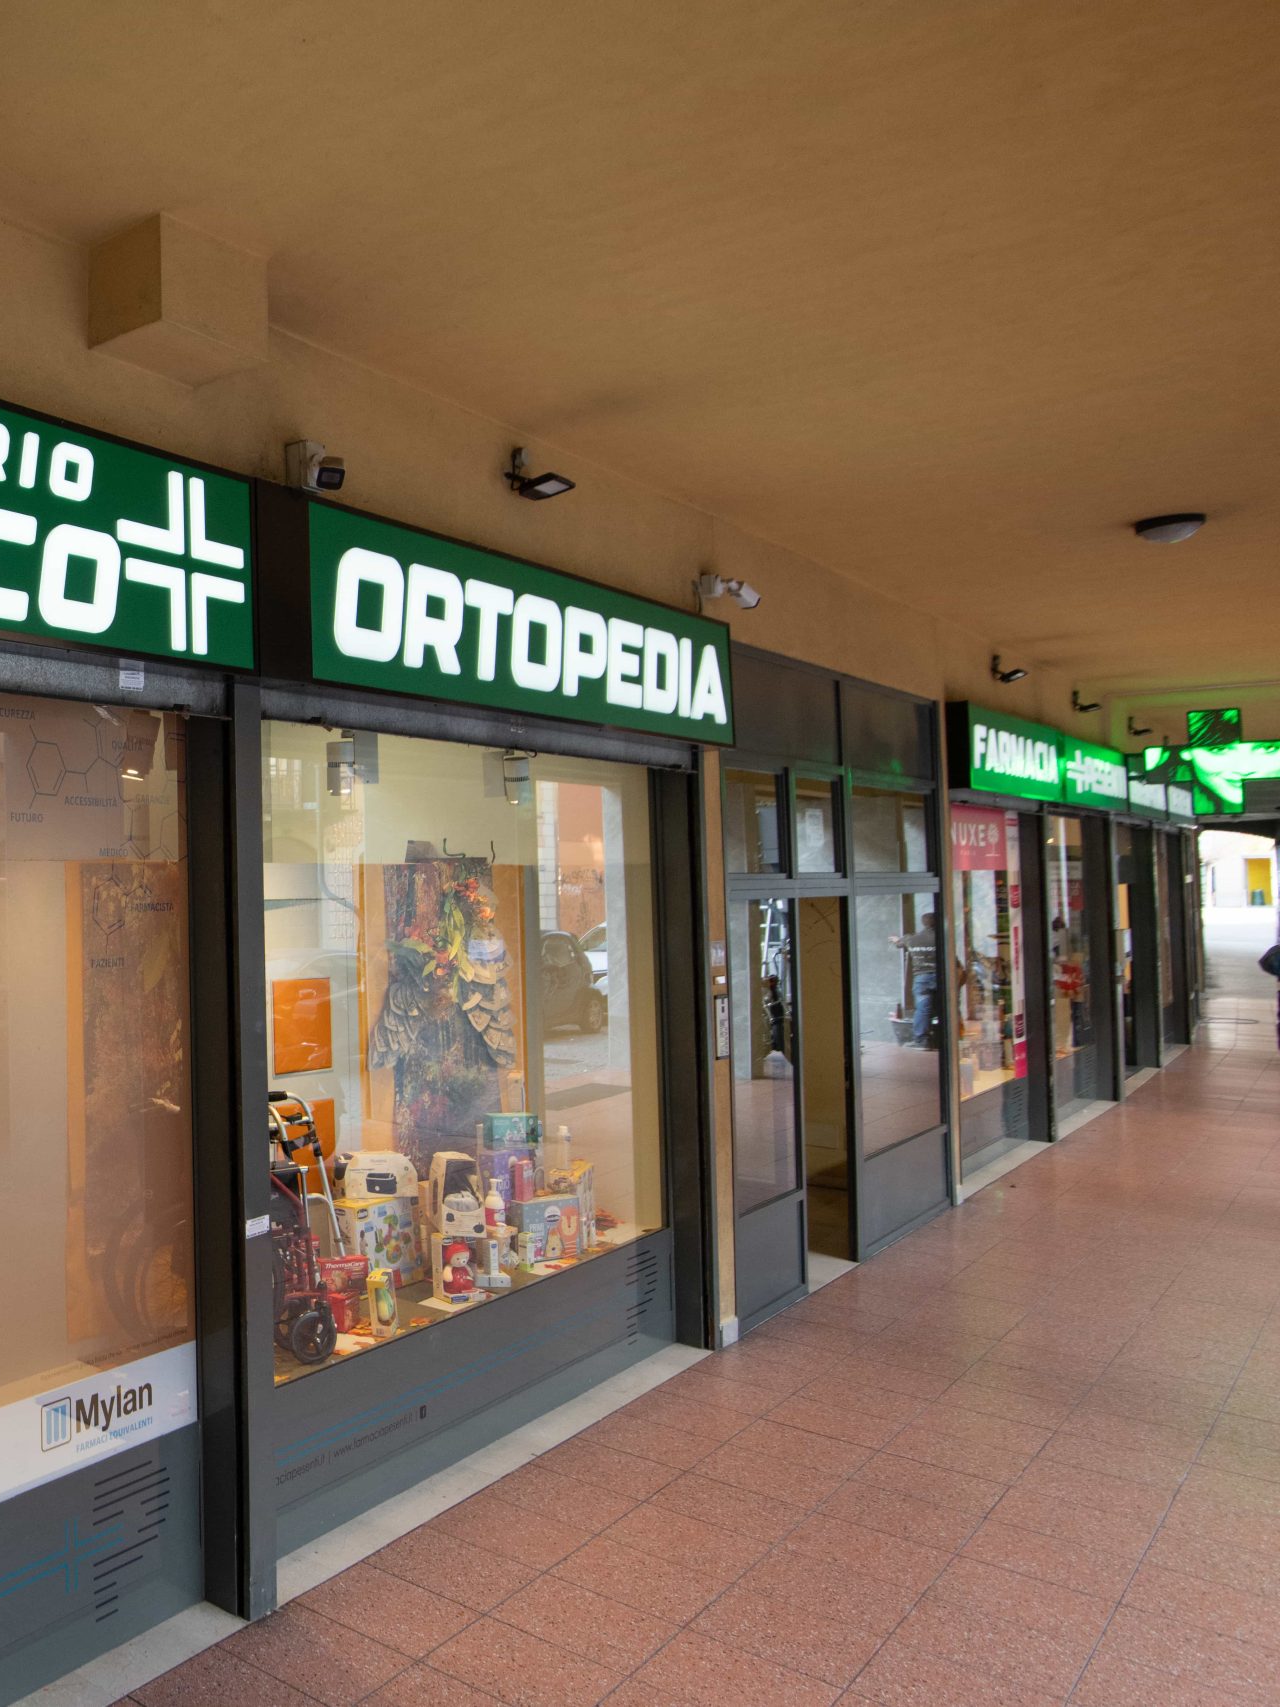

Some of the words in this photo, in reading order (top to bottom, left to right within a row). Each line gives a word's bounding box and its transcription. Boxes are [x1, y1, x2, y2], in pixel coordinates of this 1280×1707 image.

[333, 546, 727, 725] ORTOPEDIA
[973, 723, 1059, 784] FARMACIA
[10, 811, 44, 823] FUTURO
[98, 847, 129, 857] MEDICO
[130, 902, 174, 912] FARMACISTA
[90, 957, 125, 969] PAZIENTI
[75, 1382, 153, 1433] Mylan
[75, 1434, 108, 1453] FARMACI
[109, 1415, 153, 1440] EQUIVALENTI
